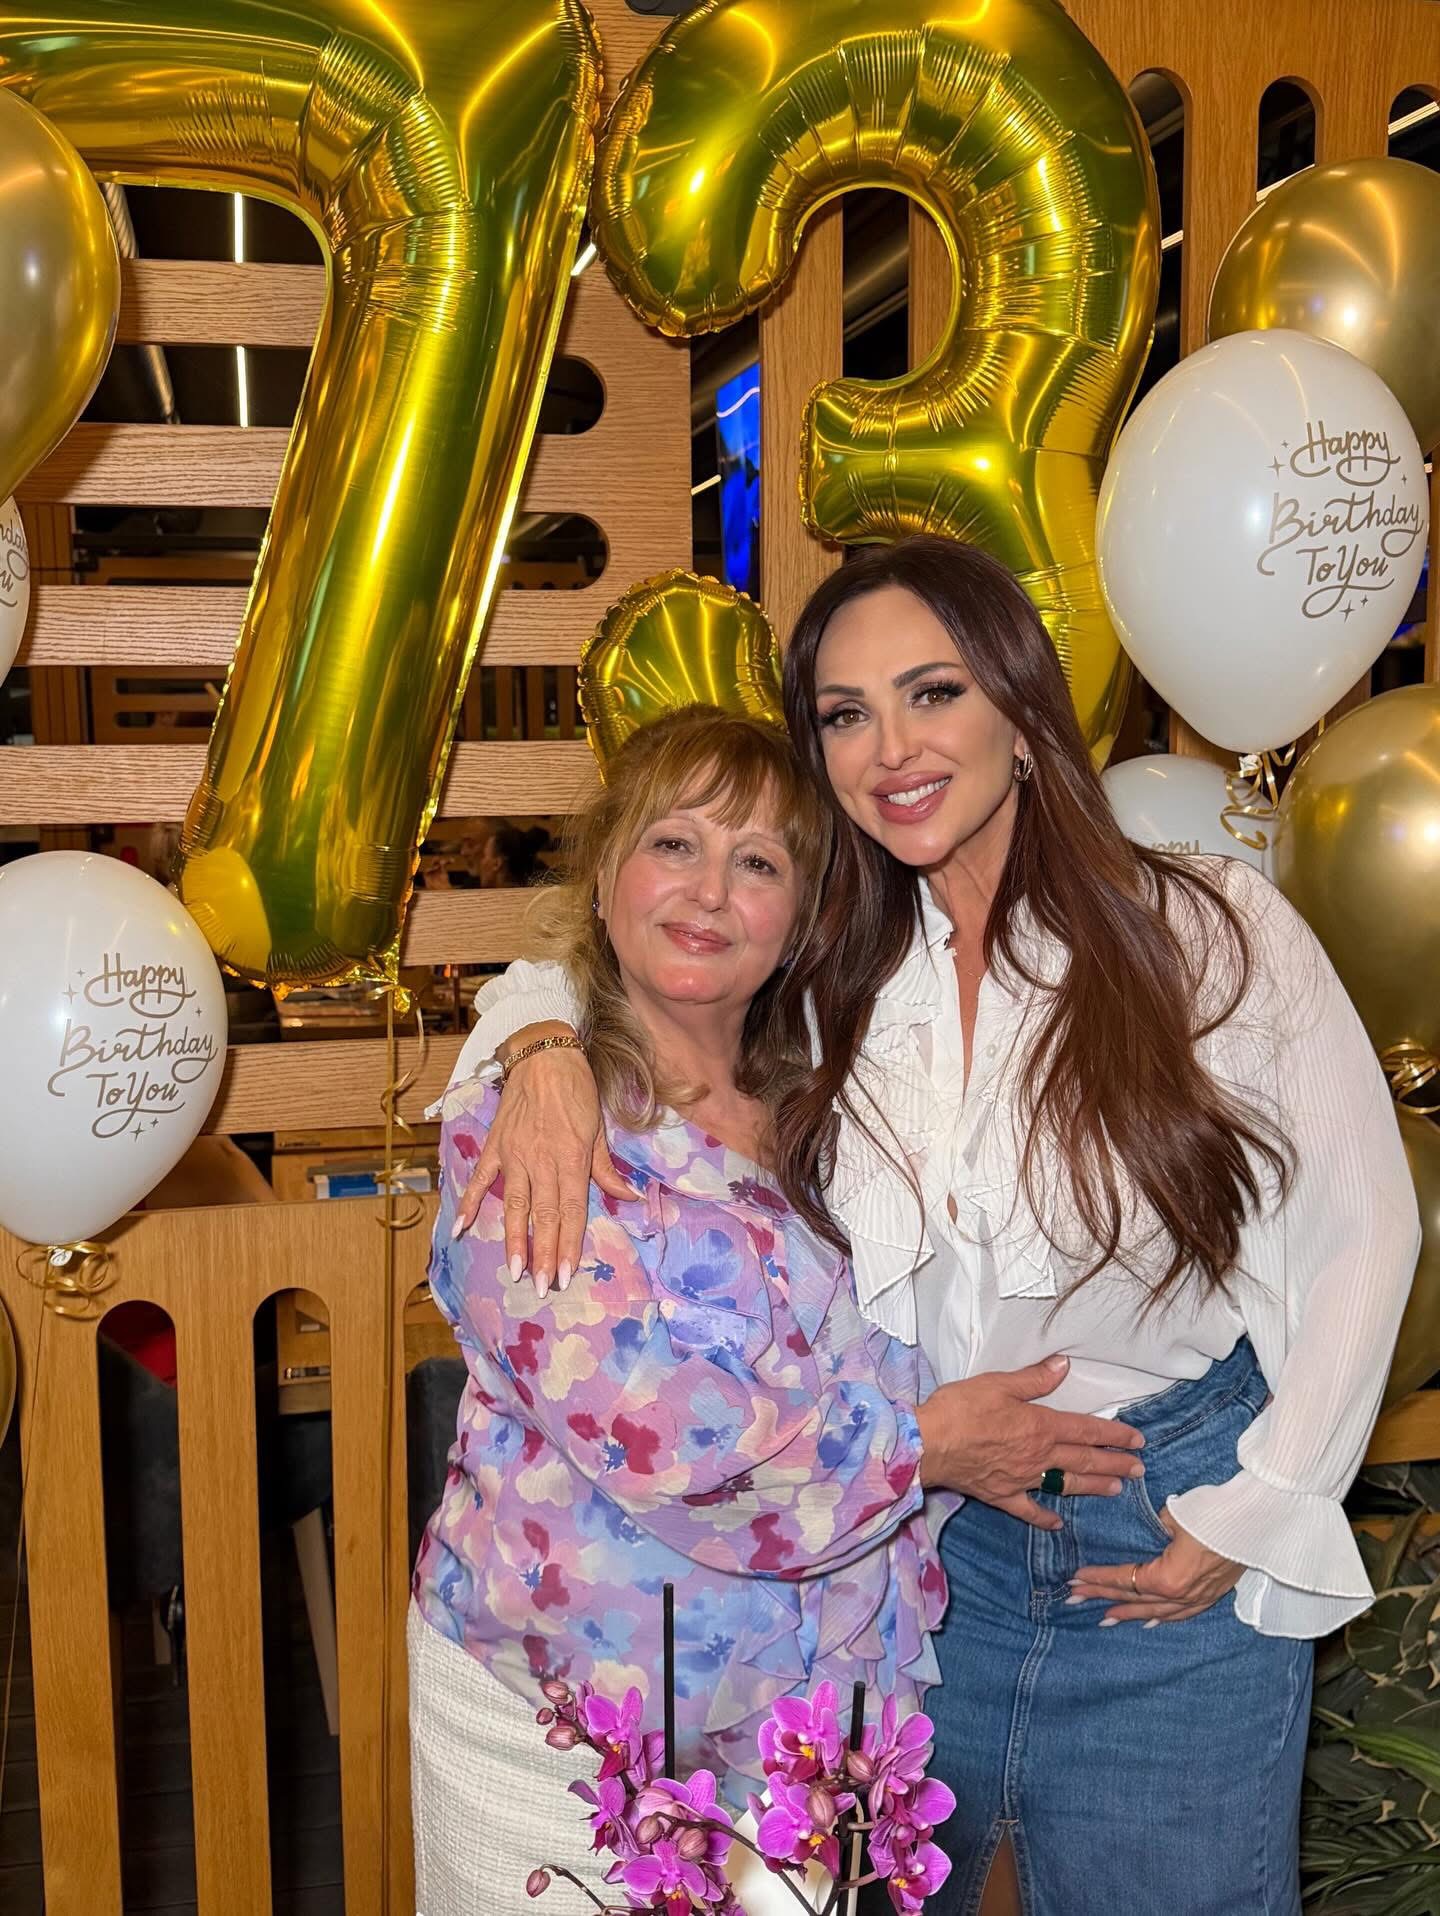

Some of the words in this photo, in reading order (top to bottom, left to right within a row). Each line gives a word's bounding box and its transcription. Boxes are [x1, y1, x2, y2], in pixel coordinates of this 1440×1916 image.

[1290, 420, 1401, 487] Happy
[1257, 490, 1424, 577] Birthday
[1296, 546, 1335, 586] To
[1302, 544, 1394, 618] You
[83, 953, 197, 1018] Happy
[47, 1018, 218, 1097] Birthday
[86, 1072, 125, 1108] To
[91, 1071, 185, 1138] You
